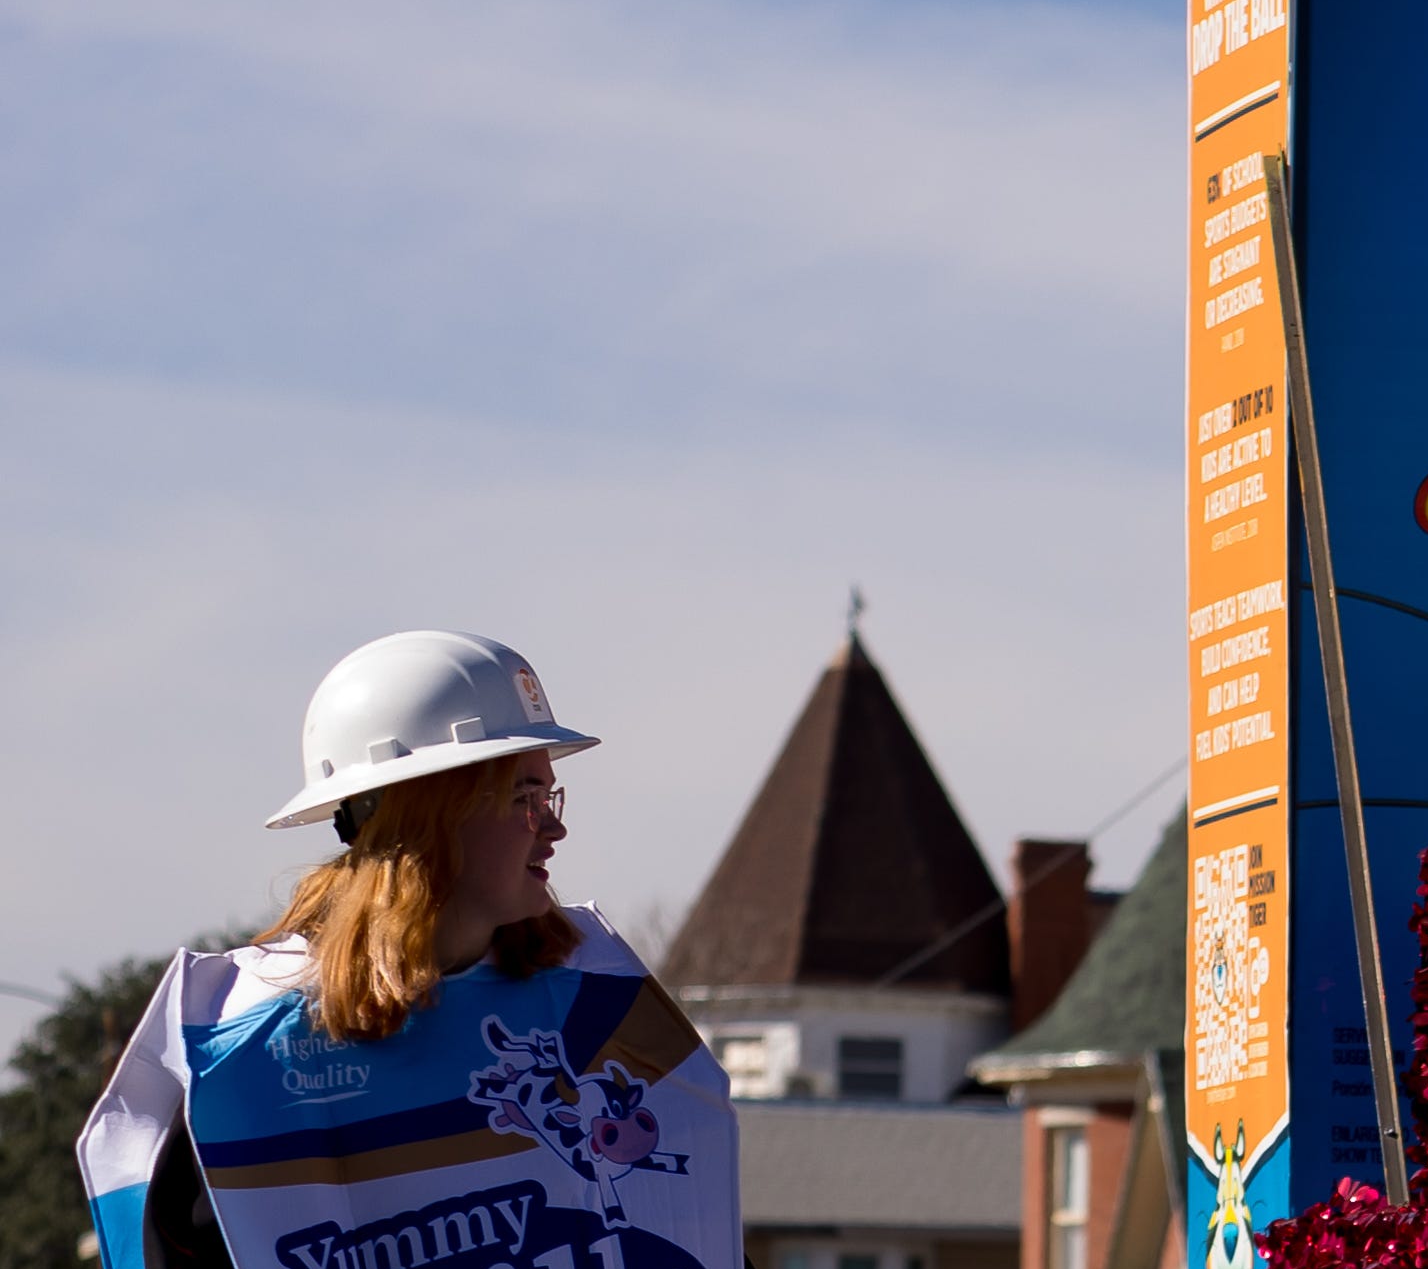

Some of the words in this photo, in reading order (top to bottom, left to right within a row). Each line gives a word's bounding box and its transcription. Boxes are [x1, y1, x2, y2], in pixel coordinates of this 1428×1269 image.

[1192, 10, 1224, 77] DROP
[1204, 209, 1230, 248] SPORTS
[1231, 191, 1267, 234] BUDGETS
[1239, 393, 1251, 425] OUT
[1254, 388, 1263, 418] OF
[1218, 443, 1232, 475] ARE
[1233, 432, 1259, 470] ACTIVE
[1260, 427, 1271, 458] TO
[1213, 595, 1236, 631] TEACH
[1223, 678, 1238, 710] CAN
[1239, 672, 1260, 706] HELP
[1249, 843, 1262, 870] JOIN
[1249, 871, 1275, 897] MISSION
[1249, 902, 1266, 928] TIGER
[282, 1063, 370, 1095] Quality
